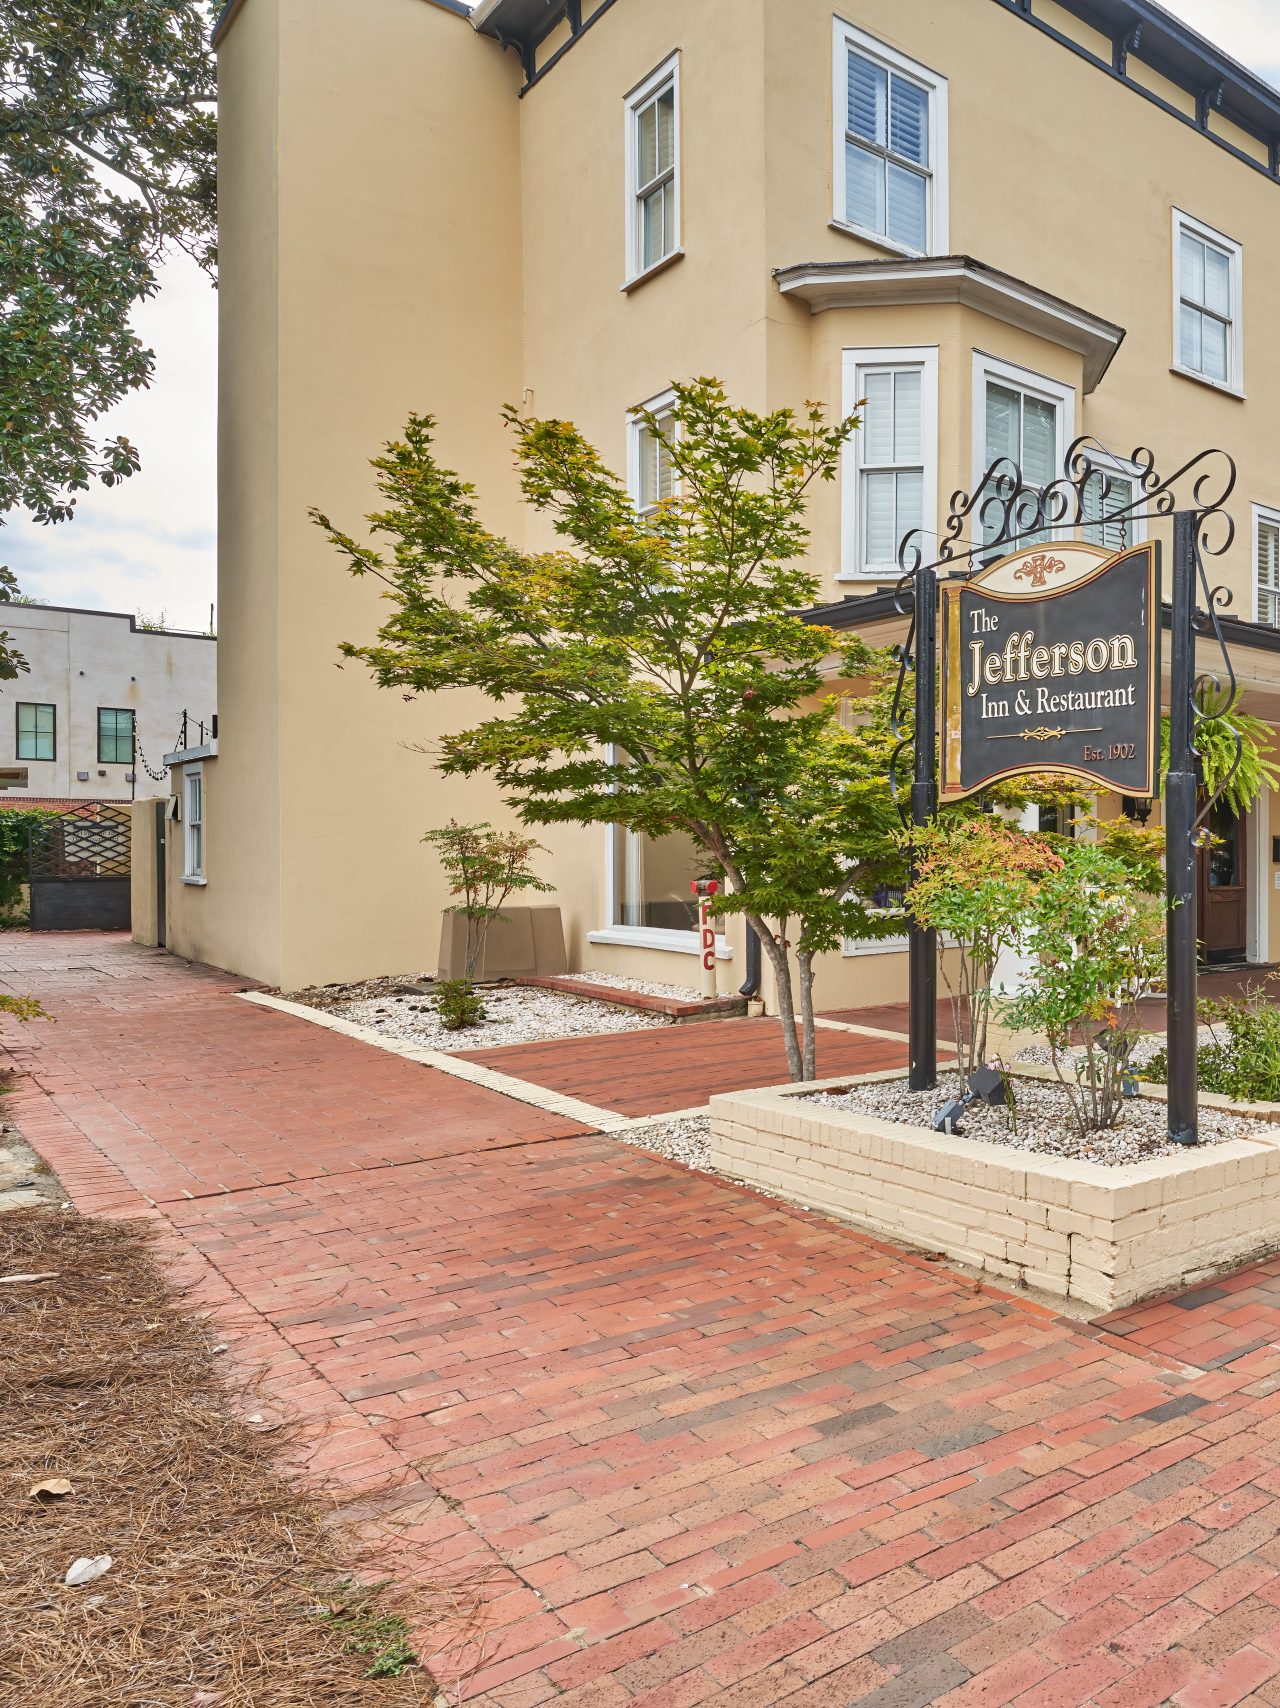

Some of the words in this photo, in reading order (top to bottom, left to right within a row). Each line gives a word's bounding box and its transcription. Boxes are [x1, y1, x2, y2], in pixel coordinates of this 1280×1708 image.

[969, 607, 999, 634] The
[967, 630, 1138, 696] Jefferson
[981, 693, 1010, 719] Inn
[1014, 690, 1033, 716] &
[1036, 684, 1136, 714] Restaurant
[1083, 745, 1104, 761] Est.
[1108, 743, 1136, 760] 1902
